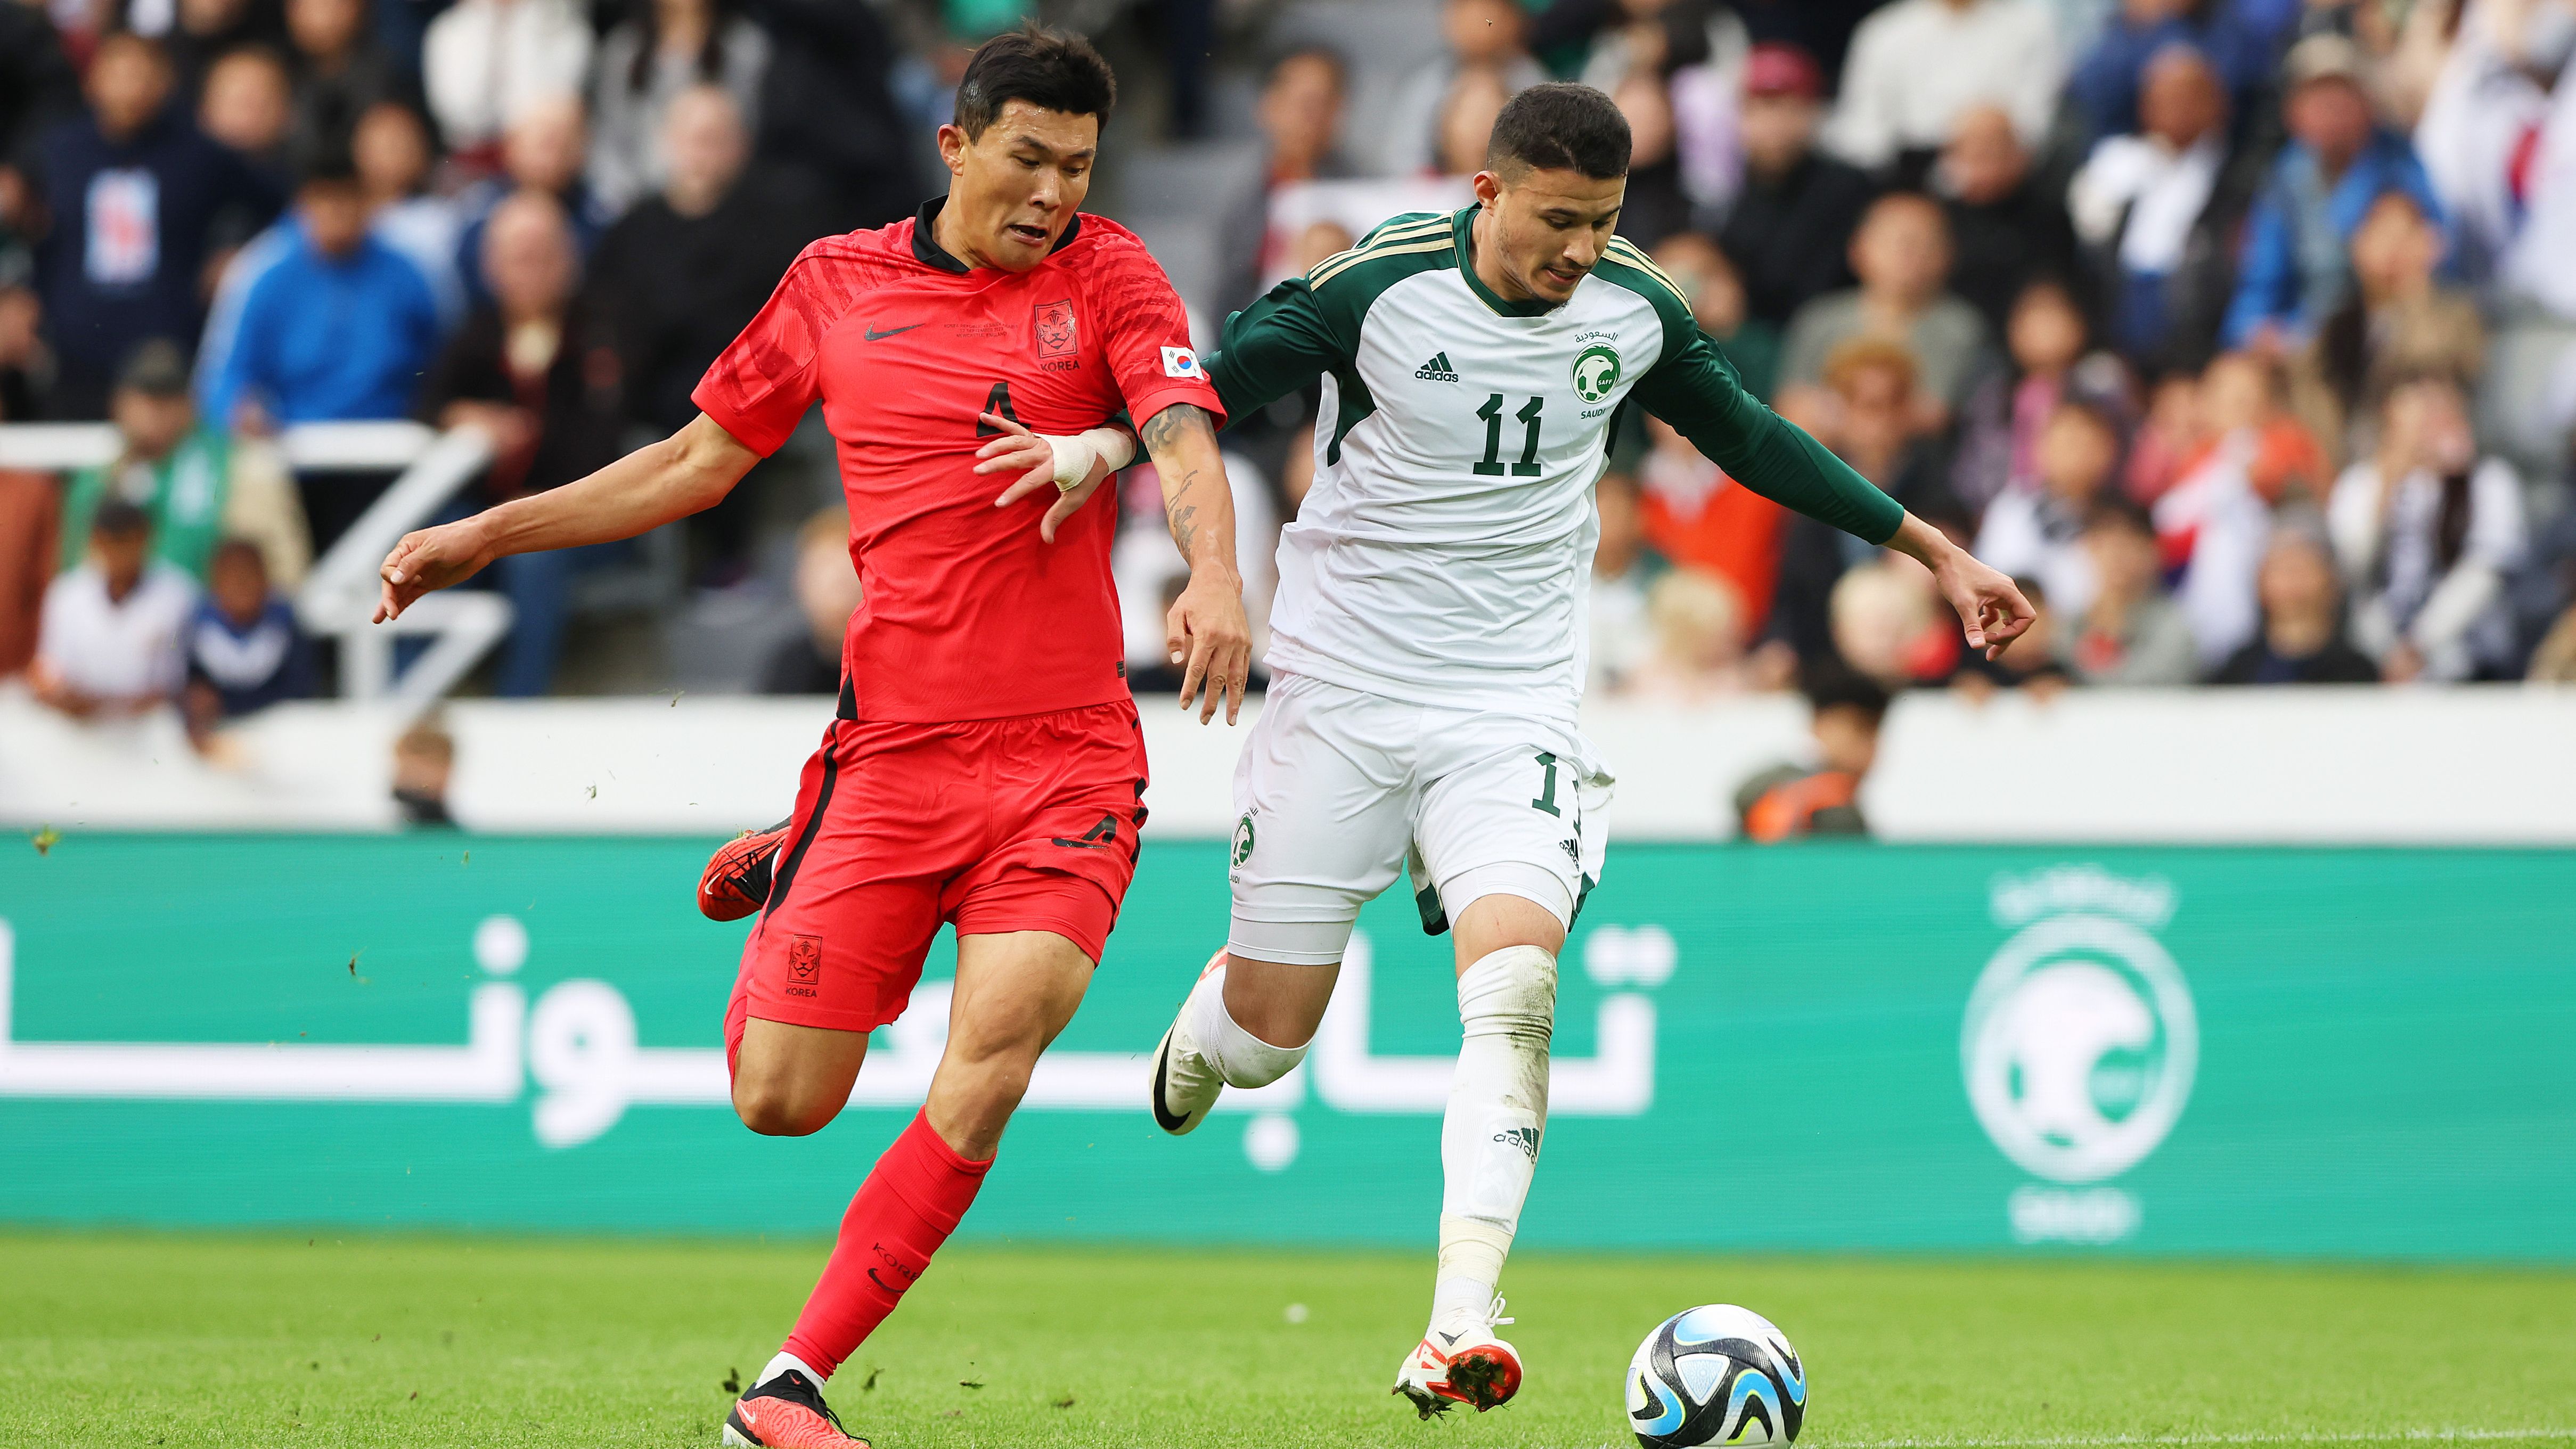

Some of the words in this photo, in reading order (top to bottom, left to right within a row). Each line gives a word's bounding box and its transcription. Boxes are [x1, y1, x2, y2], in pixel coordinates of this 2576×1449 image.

[1575, 331, 1618, 343] السعودية
[1041, 360, 1080, 371] KOREA
[1415, 370, 1459, 382] adidas
[1581, 408, 1606, 420] SAUDI
[1473, 393, 1544, 477] 11
[786, 987, 817, 997] KOREA
[1493, 1134, 1536, 1165] adida
[873, 1242, 918, 1281] KORE
